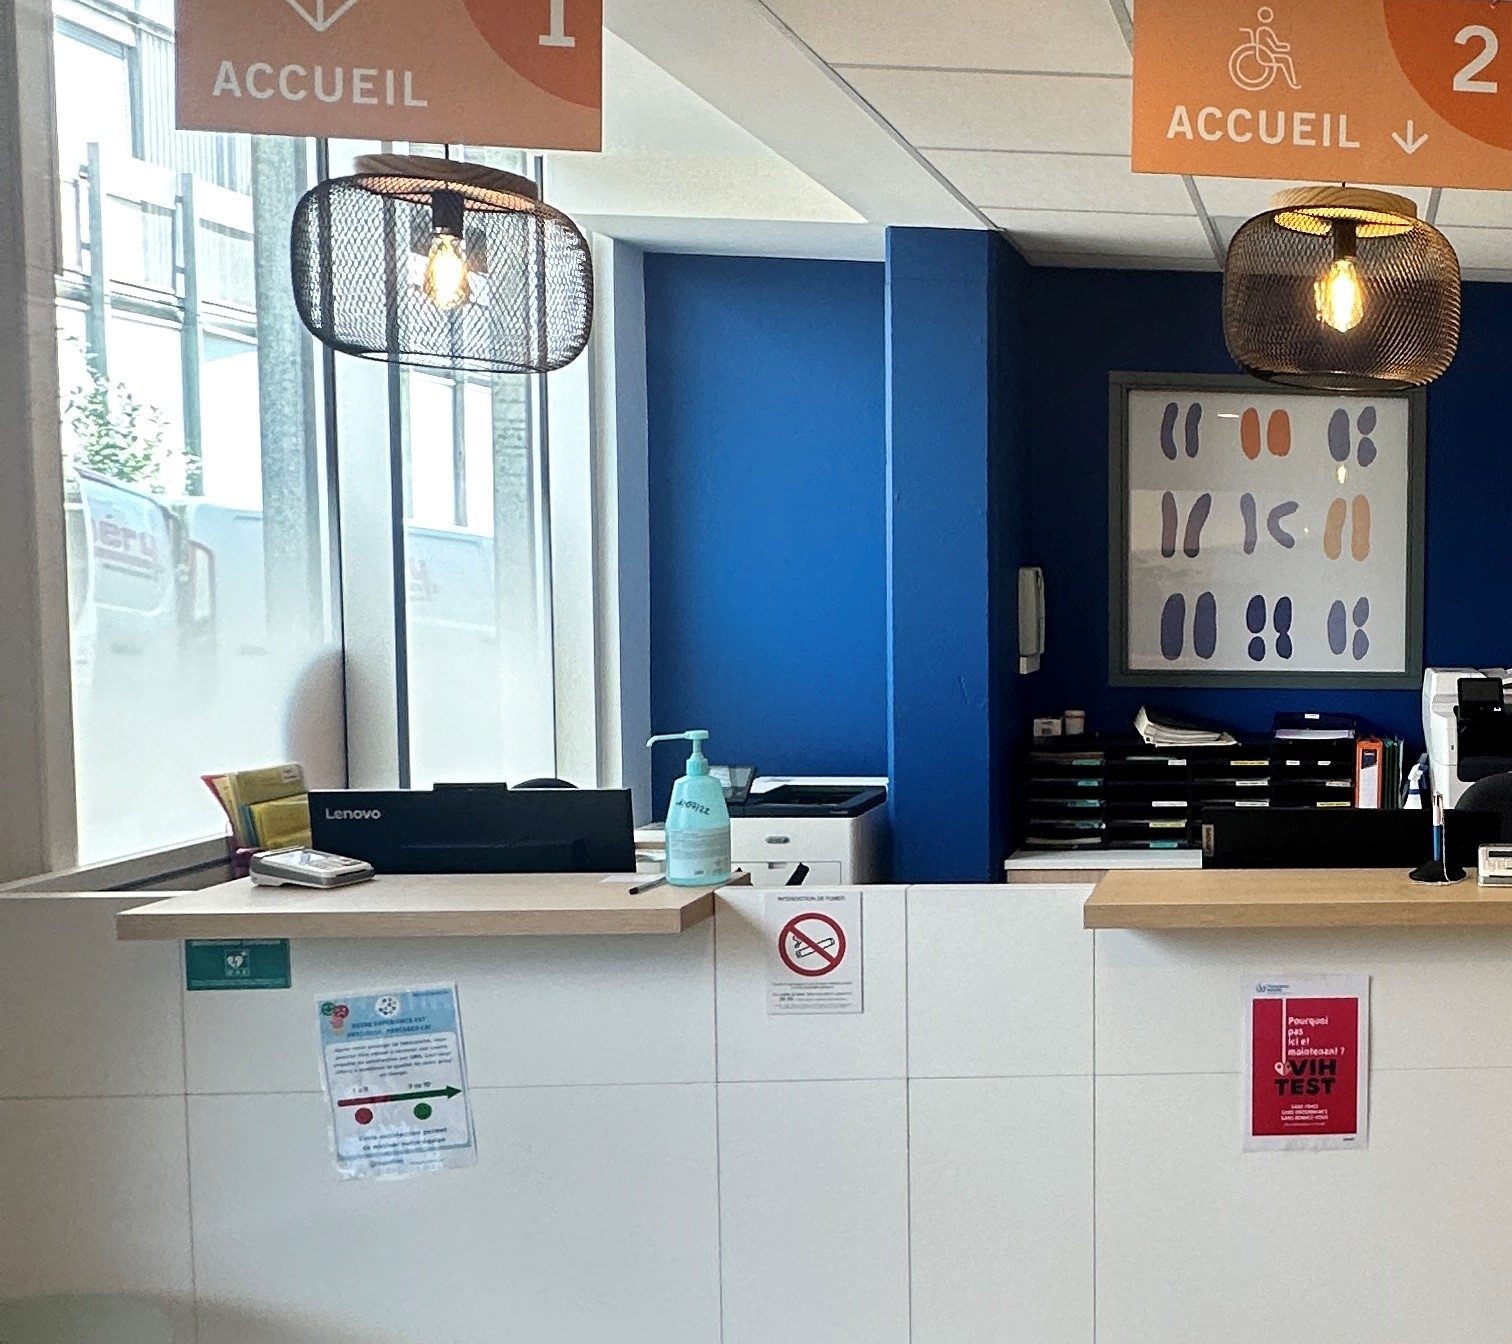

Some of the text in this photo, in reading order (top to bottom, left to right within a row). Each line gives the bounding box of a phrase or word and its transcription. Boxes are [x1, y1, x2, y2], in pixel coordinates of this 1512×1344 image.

[1453, 25, 1499, 93] 2
[213, 61, 428, 107] ACCUEIL
[1166, 105, 1360, 148] ACCUEIL
[324, 807, 381, 820] Lenovo
[1288, 1016, 1329, 1027] Pourquoi
[1287, 1028, 1304, 1037] pas
[1288, 1047, 1338, 1056] maintenant
[1289, 1059, 1337, 1076] VIH
[1274, 1077, 1336, 1096] TEST
